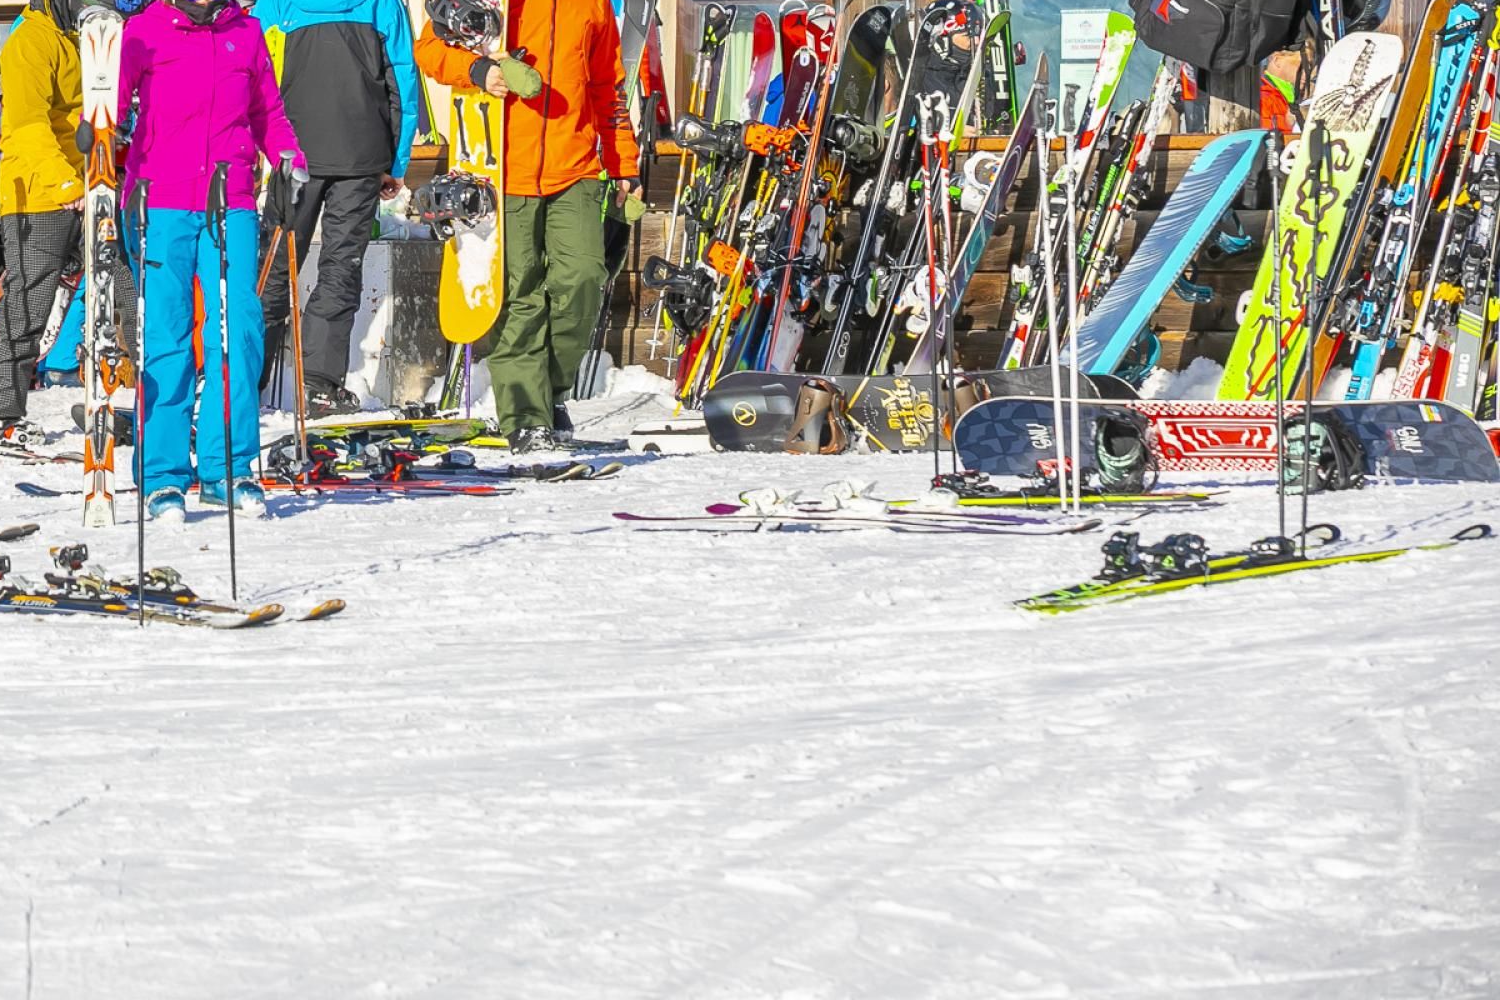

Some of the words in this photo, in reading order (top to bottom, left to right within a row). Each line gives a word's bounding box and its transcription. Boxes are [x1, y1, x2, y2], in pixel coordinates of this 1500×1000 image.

[1428, 44, 1465, 156] STÖCK
[1026, 423, 1052, 449] GNU
[1396, 425, 1424, 454] GNU
